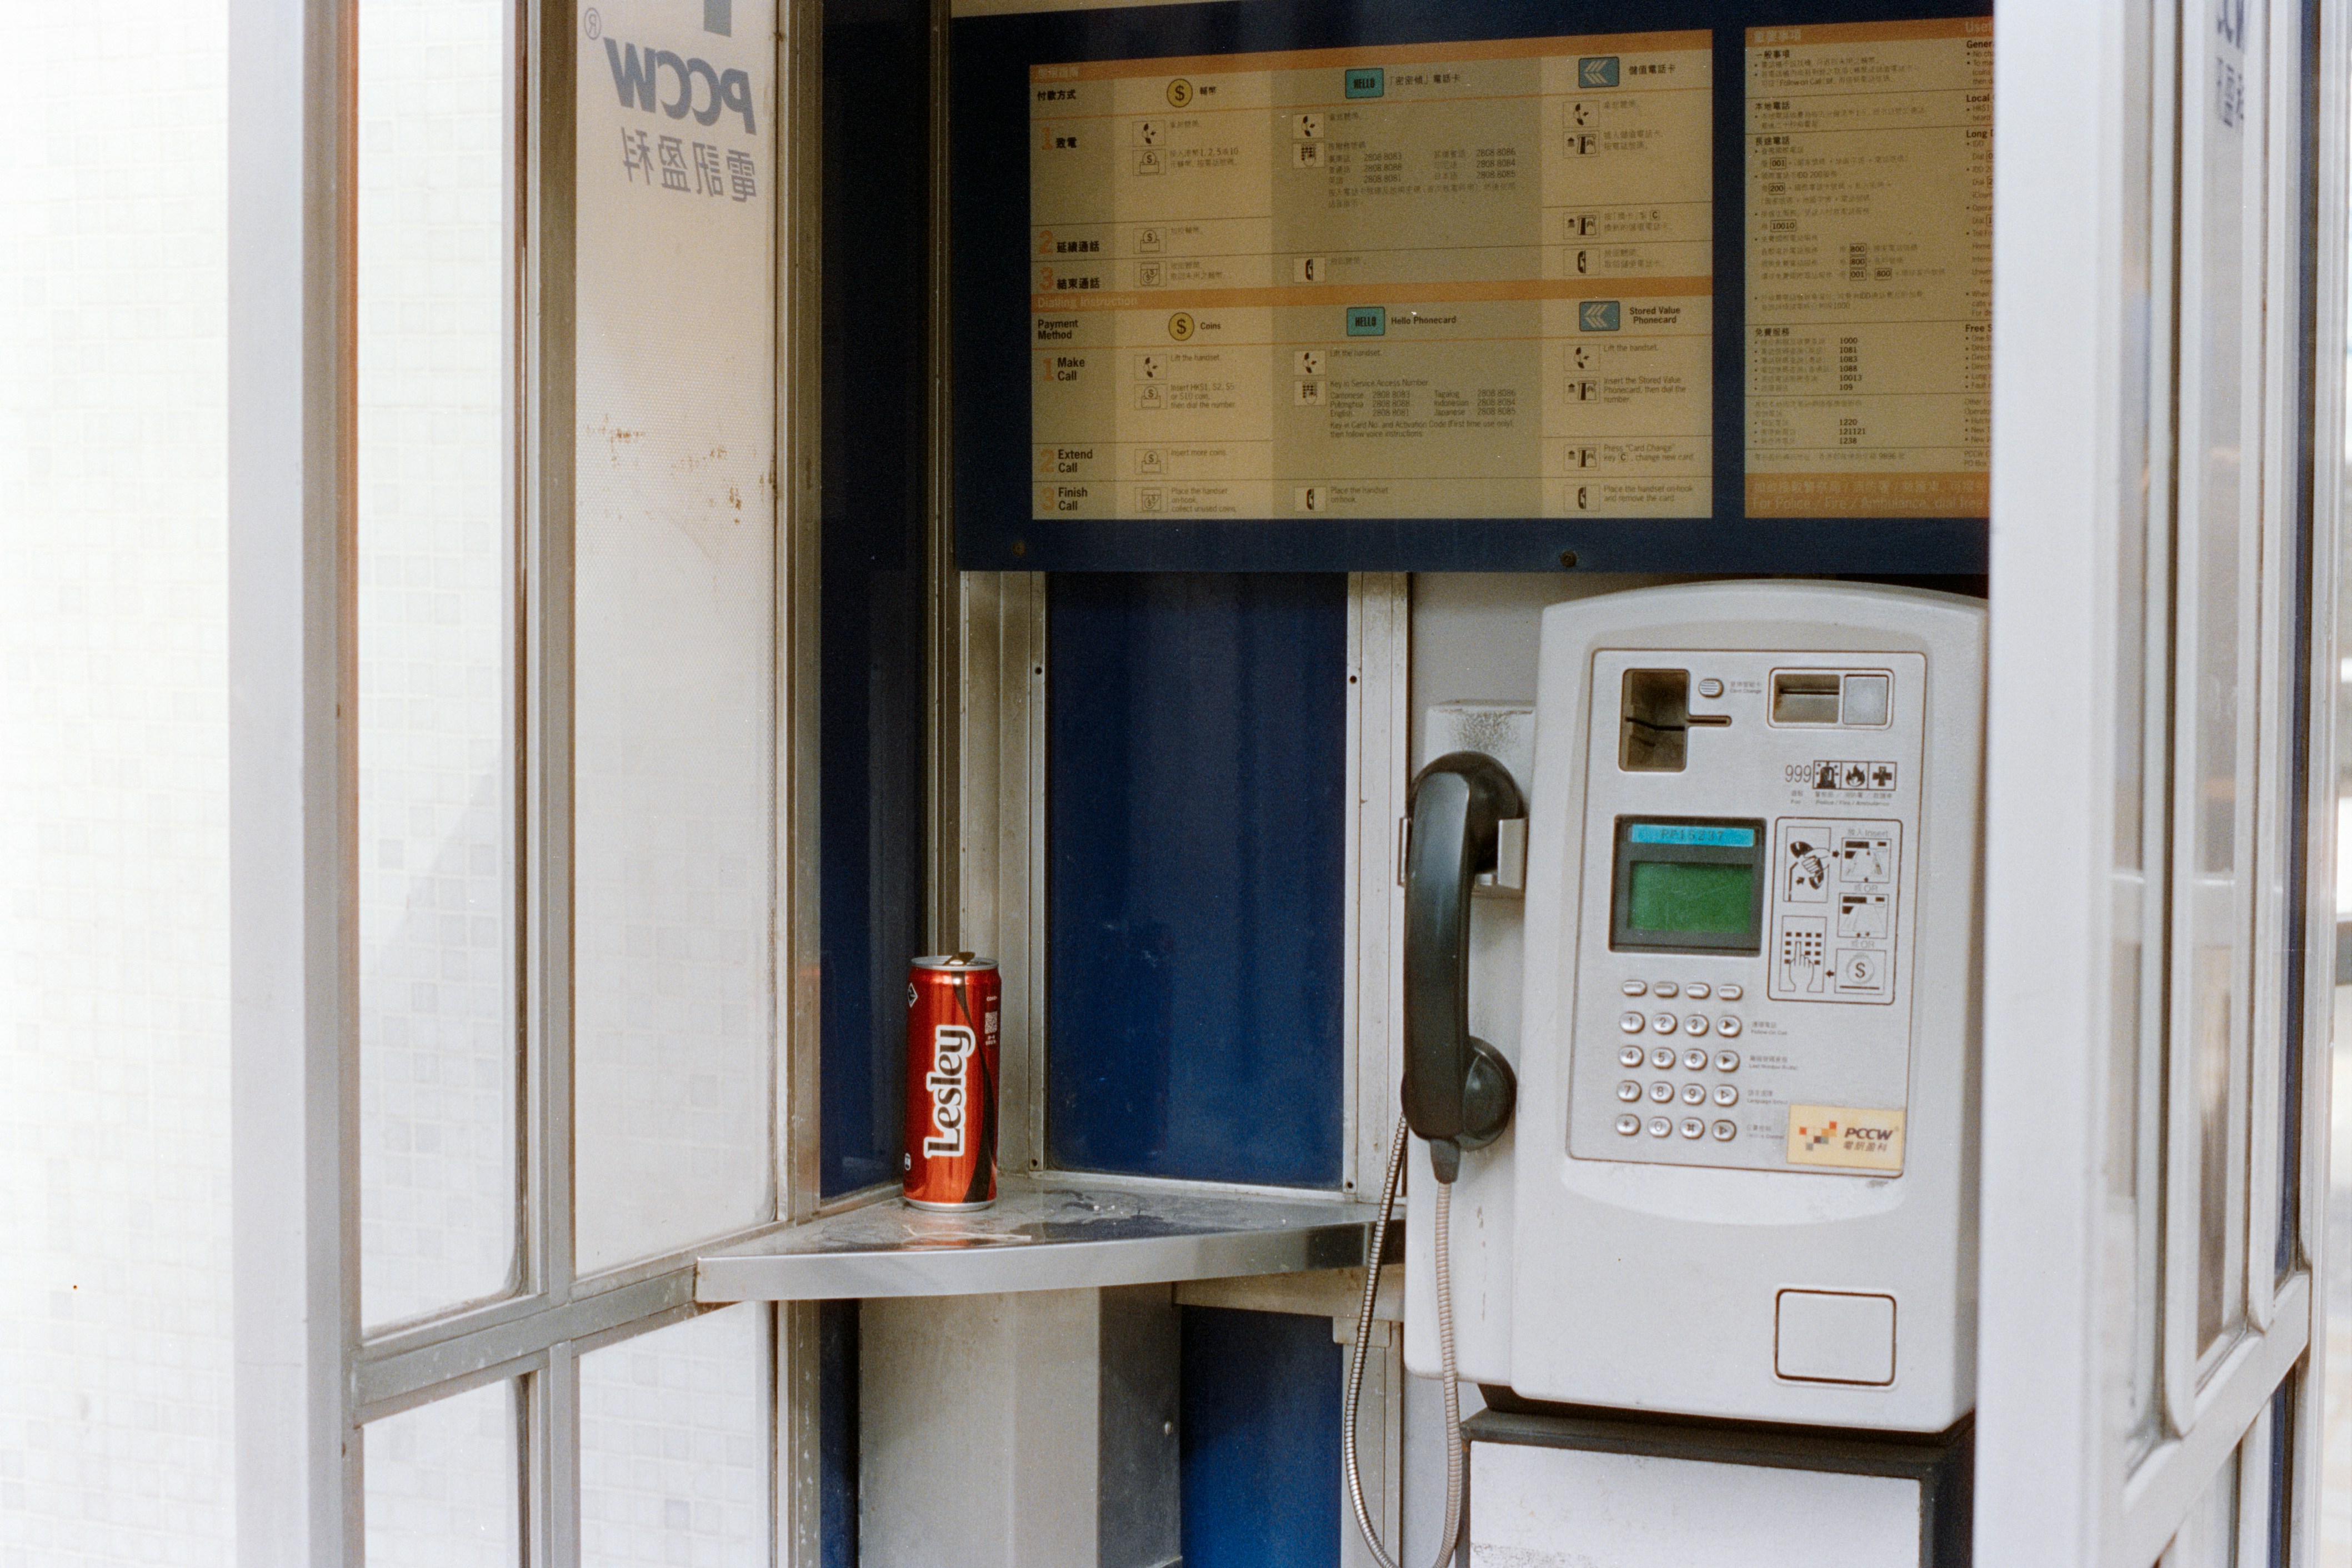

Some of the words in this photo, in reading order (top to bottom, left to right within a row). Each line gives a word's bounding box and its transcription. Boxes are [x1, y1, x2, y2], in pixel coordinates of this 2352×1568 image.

[1353, 78, 1375, 89] HELLO
[1966, 93, 1990, 102] Local
[1966, 129, 1987, 139] Long
[1630, 307, 1656, 315] Stored
[1659, 306, 1680, 314] Value
[1038, 319, 1078, 330] Payment
[1355, 317, 1376, 327] HELLO
[1413, 316, 1457, 324] Phonecard
[1200, 322, 1221, 330] Coins
[1965, 324, 1985, 332] Free
[1038, 330, 1072, 340] Method
[1057, 357, 1085, 368] Make
[1057, 370, 1077, 381] Call
[1058, 449, 1093, 460] Extend
[1040, 449, 1054, 473] 2
[1058, 462, 1078, 473] Call
[1058, 487, 1088, 498] Finish
[1041, 488, 1054, 510] 3
[1058, 500, 1078, 511] Call
[1785, 765, 1811, 783] 999
[1659, 1016, 1667, 1028] 2
[1692, 1019, 1698, 1030] 3
[1627, 1050, 1633, 1060] 4
[1658, 1051, 1664, 1063] 5
[1690, 1053, 1698, 1064] 6
[924, 1026, 974, 1158] Lesley
[1624, 1085, 1632, 1095] 7
[1657, 1086, 1664, 1097] 8
[1689, 1088, 1696, 1098] 9
[1655, 1121, 1662, 1131] 0
[1844, 1127, 1893, 1140] PCCW
